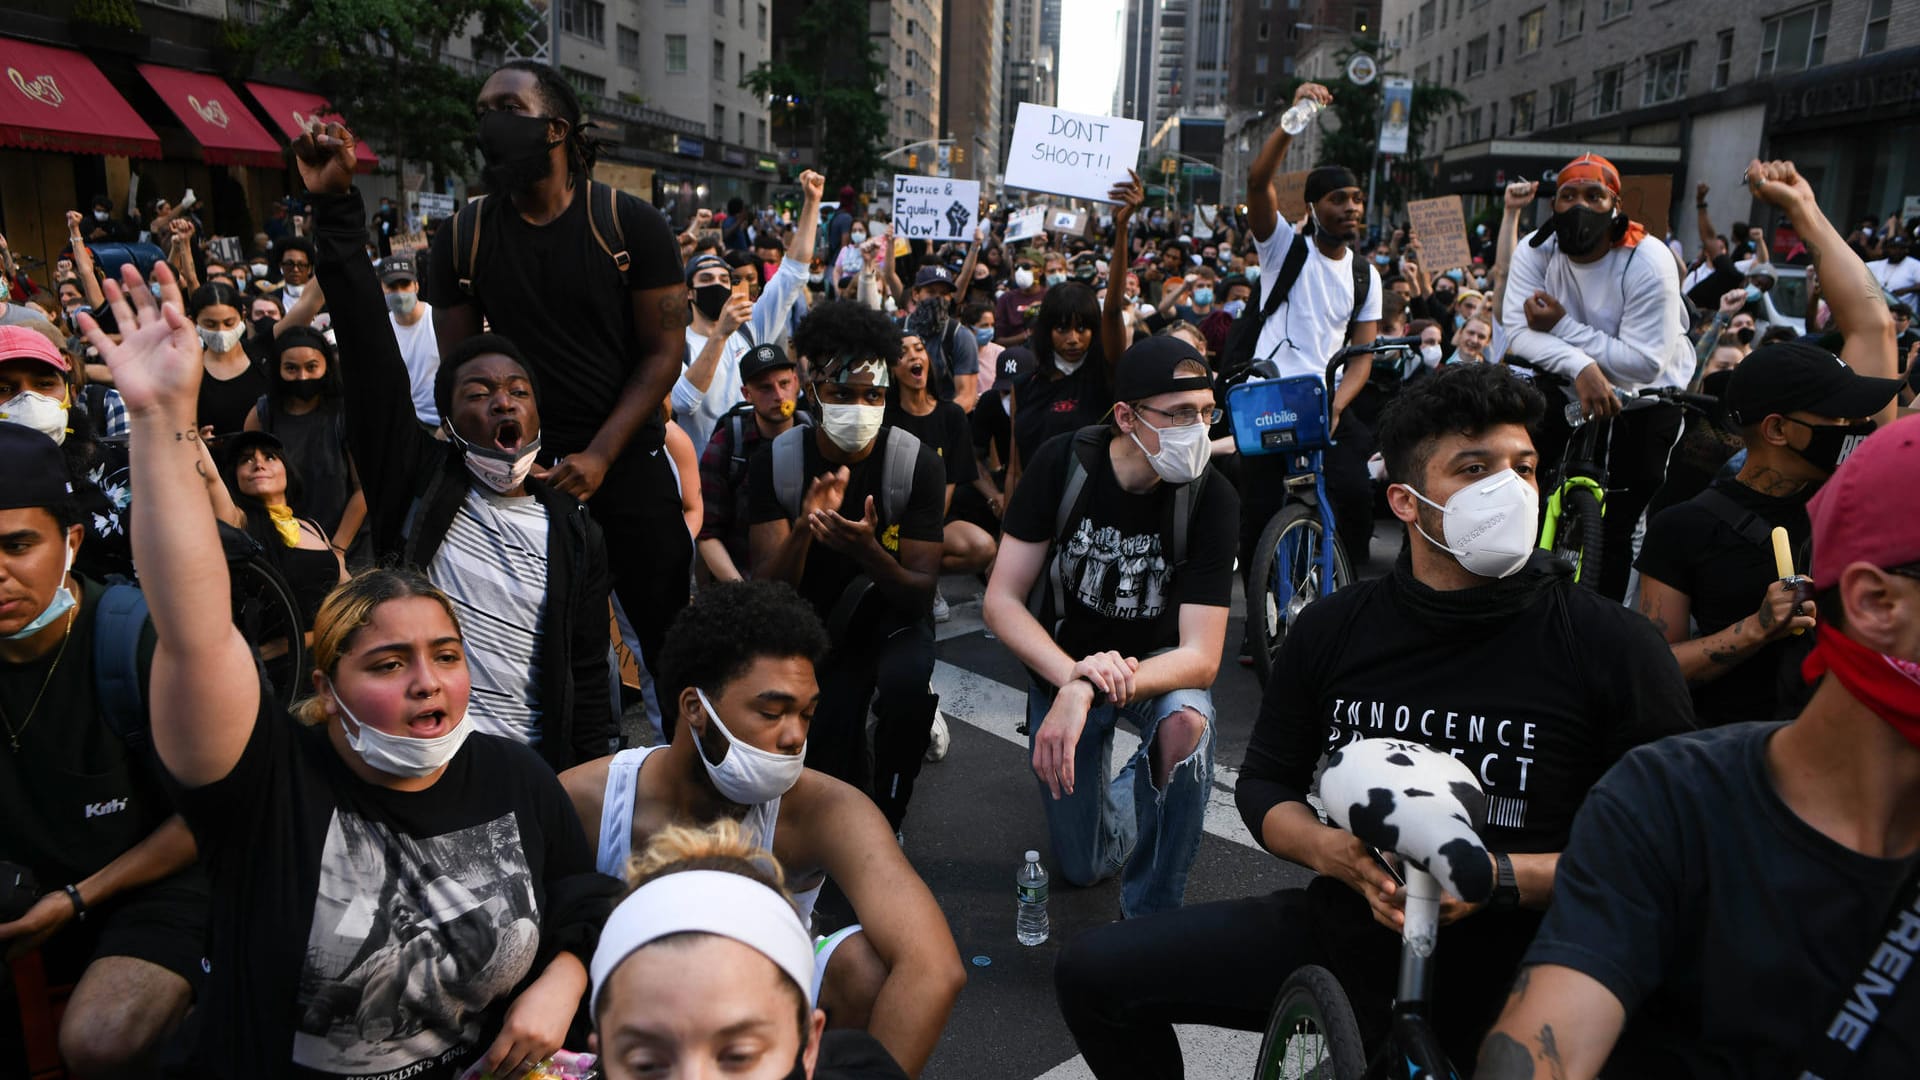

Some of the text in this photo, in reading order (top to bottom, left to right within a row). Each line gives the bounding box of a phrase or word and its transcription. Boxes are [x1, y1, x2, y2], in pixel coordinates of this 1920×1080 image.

[1048, 114, 1110, 143] DONT
[1032, 142, 1111, 178] SHOOT!!
[944, 182, 953, 196] &
[895, 198, 938, 218] Equality
[894, 217, 940, 236] Now!
[1255, 410, 1298, 427] citi bike
[1333, 699, 1537, 750] INNOCENCE
